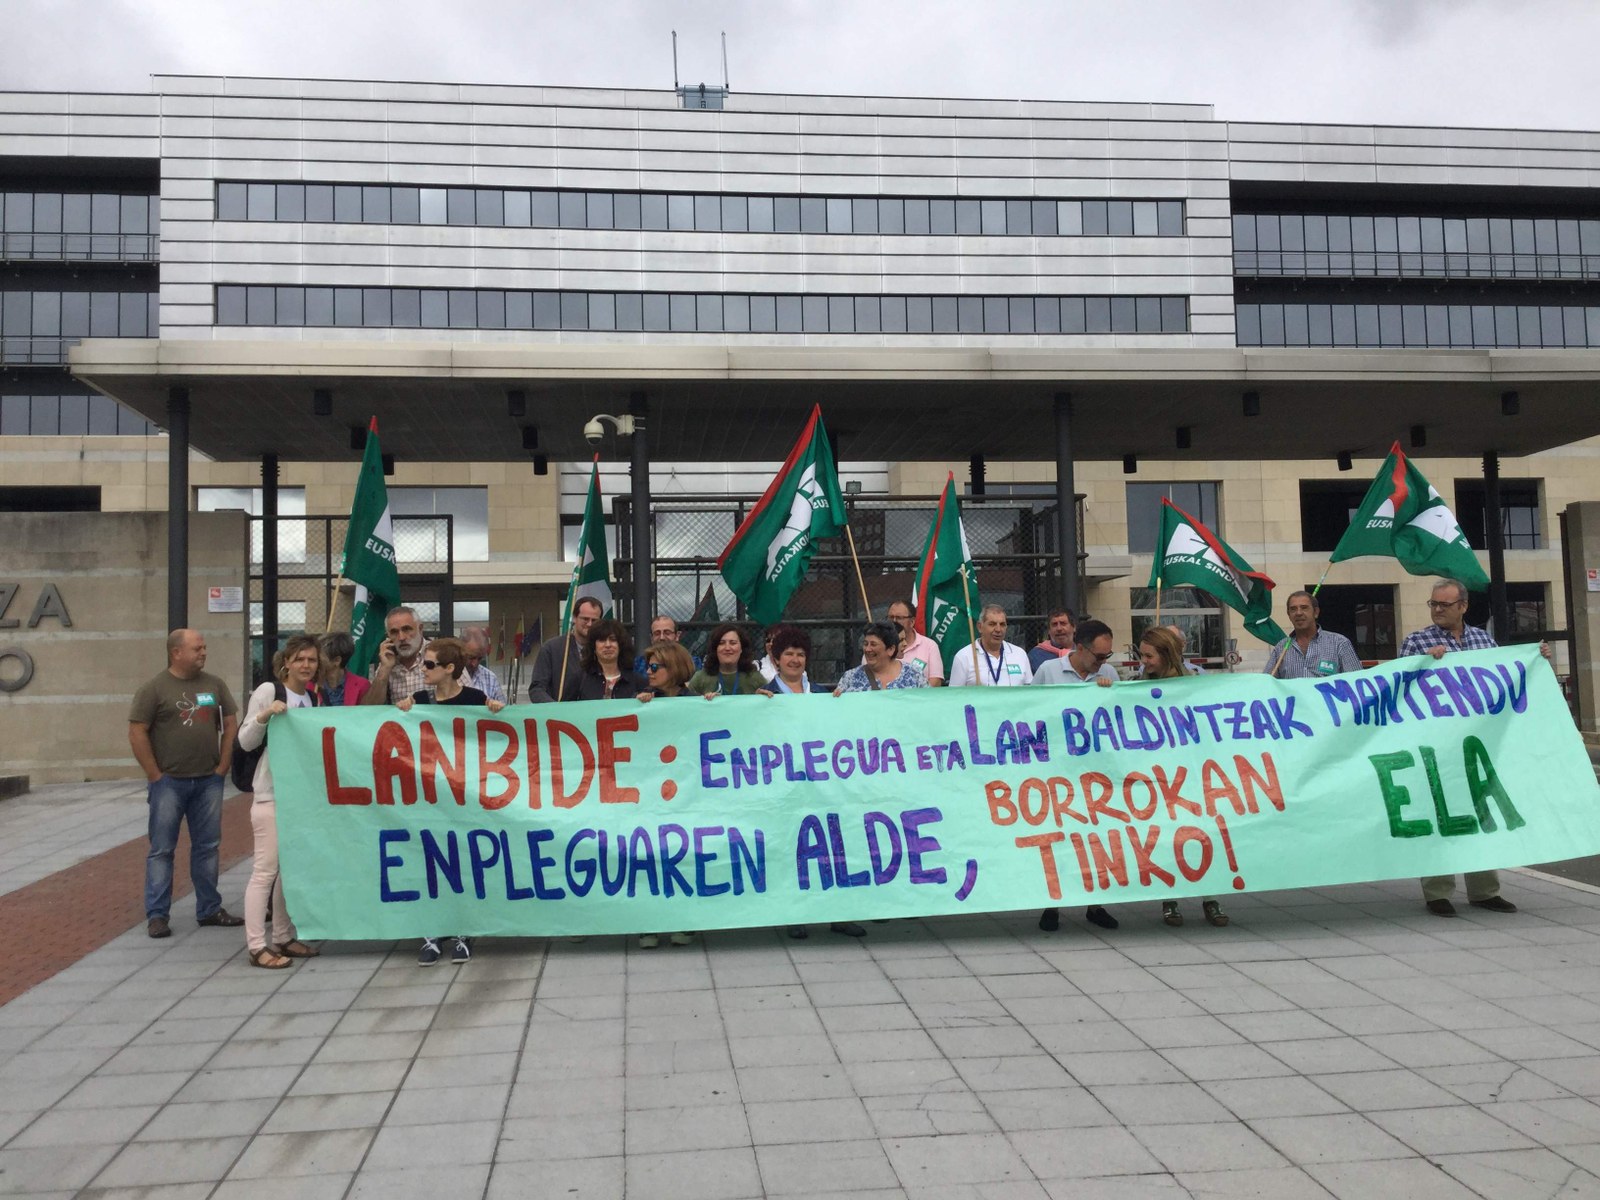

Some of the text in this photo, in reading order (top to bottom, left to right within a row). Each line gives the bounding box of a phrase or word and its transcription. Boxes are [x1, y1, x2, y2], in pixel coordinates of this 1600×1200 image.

[700, 729, 906, 789] ENPLEGUA
[916, 740, 965, 773] ETA
[965, 704, 1050, 766] LAN
[1062, 688, 1313, 756] BALDINTZAK
[1314, 660, 1528, 727] MANTENDU
[985, 752, 1286, 827] BORROKAN
[1368, 735, 1526, 838] ELA
[379, 807, 978, 902] ENPLEGUAREN ALDE,
[1015, 814, 1245, 900] TINKO!
